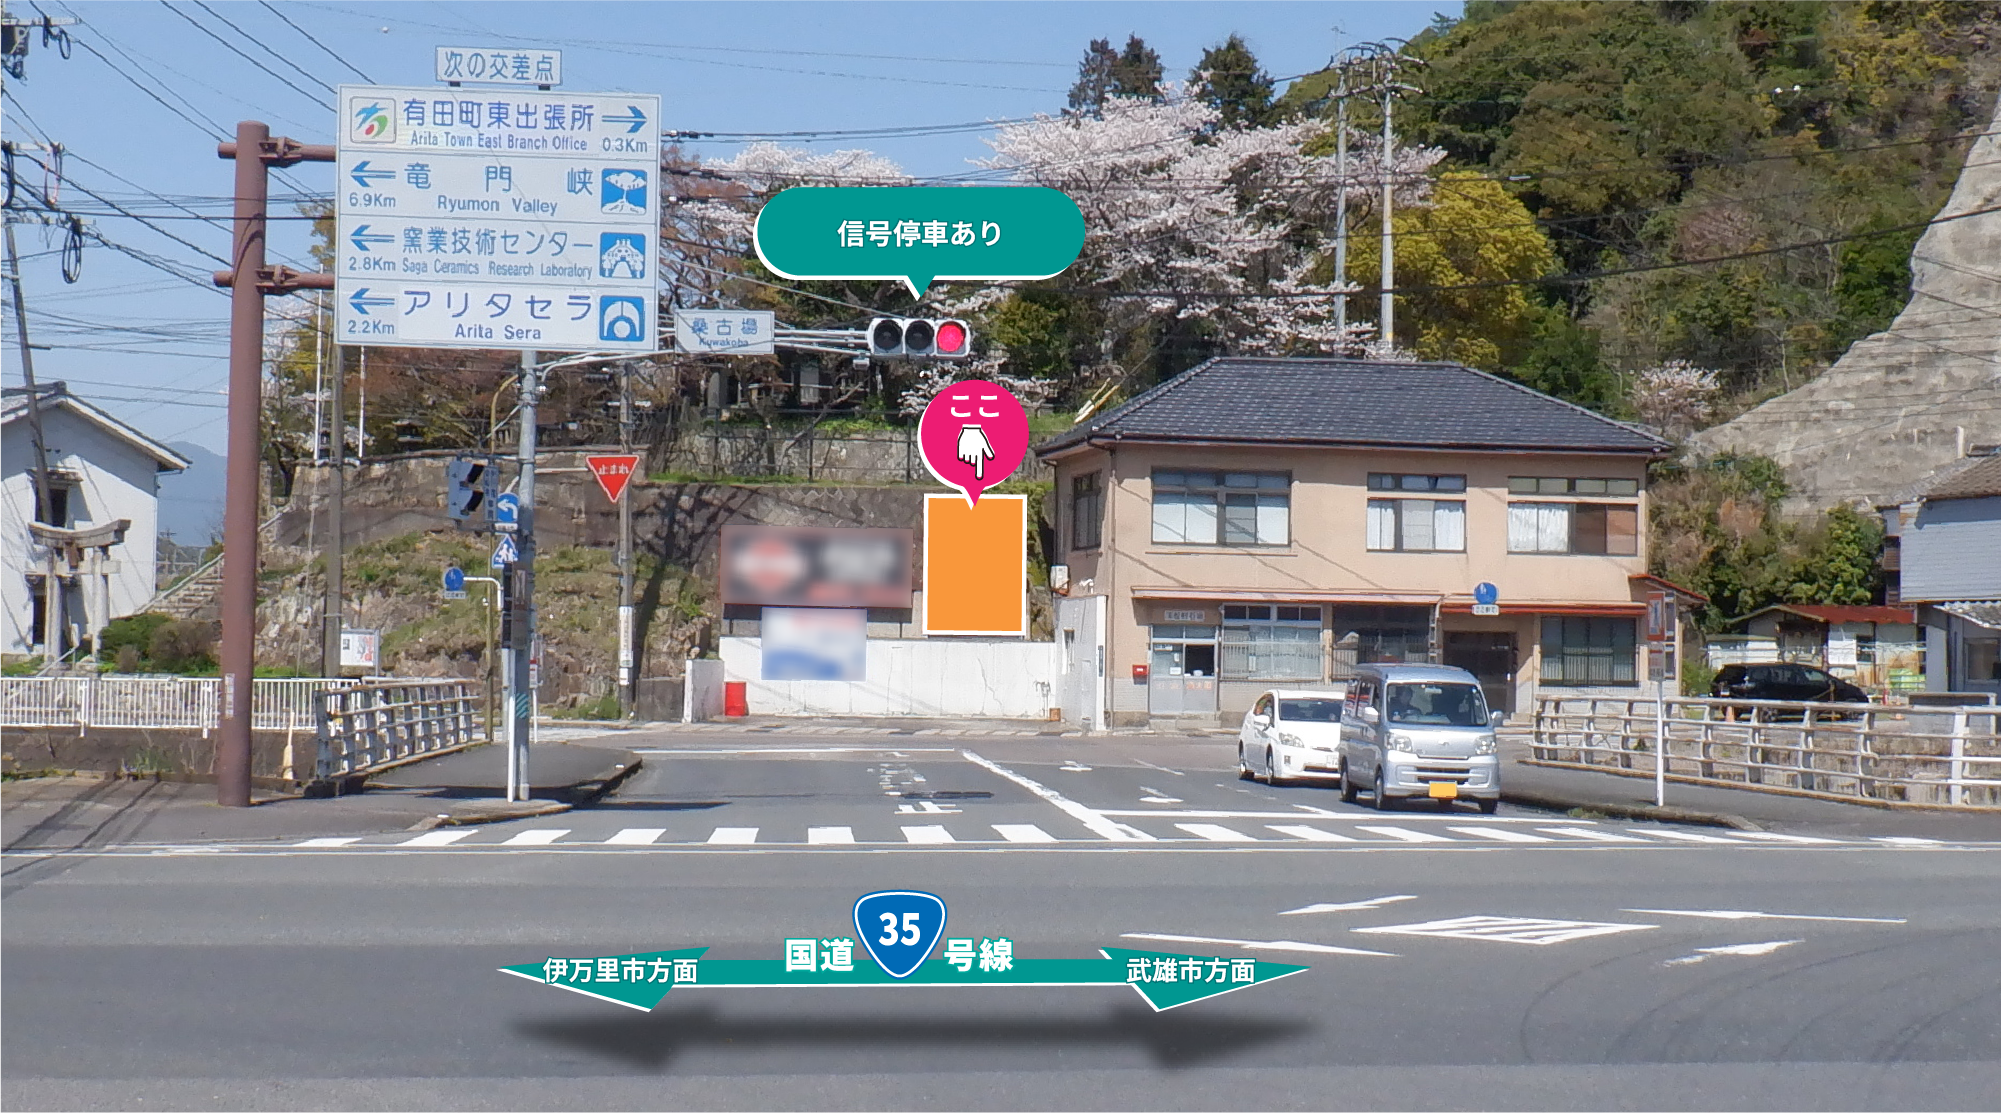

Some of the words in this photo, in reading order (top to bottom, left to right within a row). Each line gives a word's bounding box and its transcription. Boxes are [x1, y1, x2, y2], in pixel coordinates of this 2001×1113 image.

[443, 50, 554, 82] 次の交差点
[403, 97, 594, 133] 有田町東出張所
[410, 132, 438, 147] Arita
[444, 133, 473, 148] Town
[478, 133, 503, 149] East
[507, 134, 548, 150] Branch
[552, 135, 588, 151] Office
[602, 137, 648, 153] 0.3Km
[349, 192, 396, 208] 6.9Km
[437, 195, 500, 213] Ryumon
[512, 197, 558, 216] Valley
[402, 226, 593, 257] 窯業技術センター
[348, 256, 396, 272] 2.8Km
[402, 259, 428, 275] Saga
[434, 259, 480, 275] Ceramics
[488, 261, 534, 277] Research
[540, 262, 593, 280] Laboratory
[403, 290, 593, 322] アリタセラ
[347, 319, 395, 335] 2.2Km
[455, 323, 493, 339] Arita
[504, 324, 541, 340] Sera
[699, 338, 749, 347] Kuwakoba
